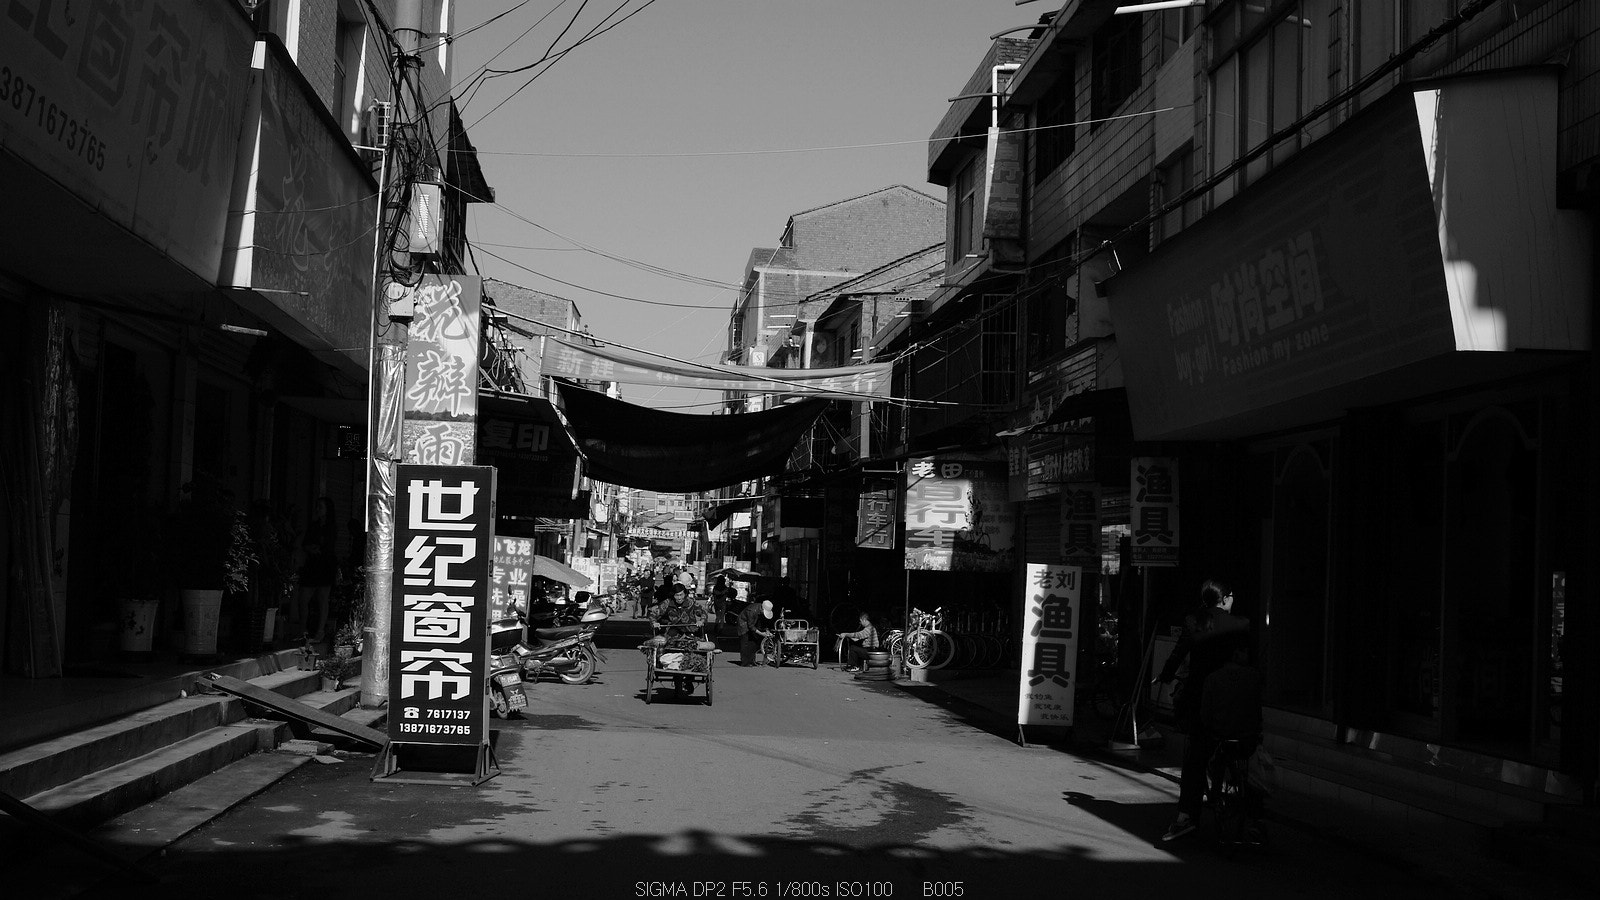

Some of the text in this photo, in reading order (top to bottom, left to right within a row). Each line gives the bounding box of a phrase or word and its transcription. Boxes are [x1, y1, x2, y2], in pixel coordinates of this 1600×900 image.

[1210, 230, 1325, 347] 时尚空间
[408, 279, 472, 465] 花瓣雨
[1222, 323, 1330, 377] Fashion my zone
[481, 418, 550, 452] 复印
[911, 461, 963, 479] 老田
[1065, 489, 1097, 555] 渔具
[1135, 465, 1173, 545] 渔具
[400, 479, 480, 701] 世纪窗帘
[1033, 568, 1076, 591] 老刘
[1027, 593, 1073, 688] 渔具
[399, 723, 471, 735] 13871673765
[427, 709, 471, 720] 7617137
